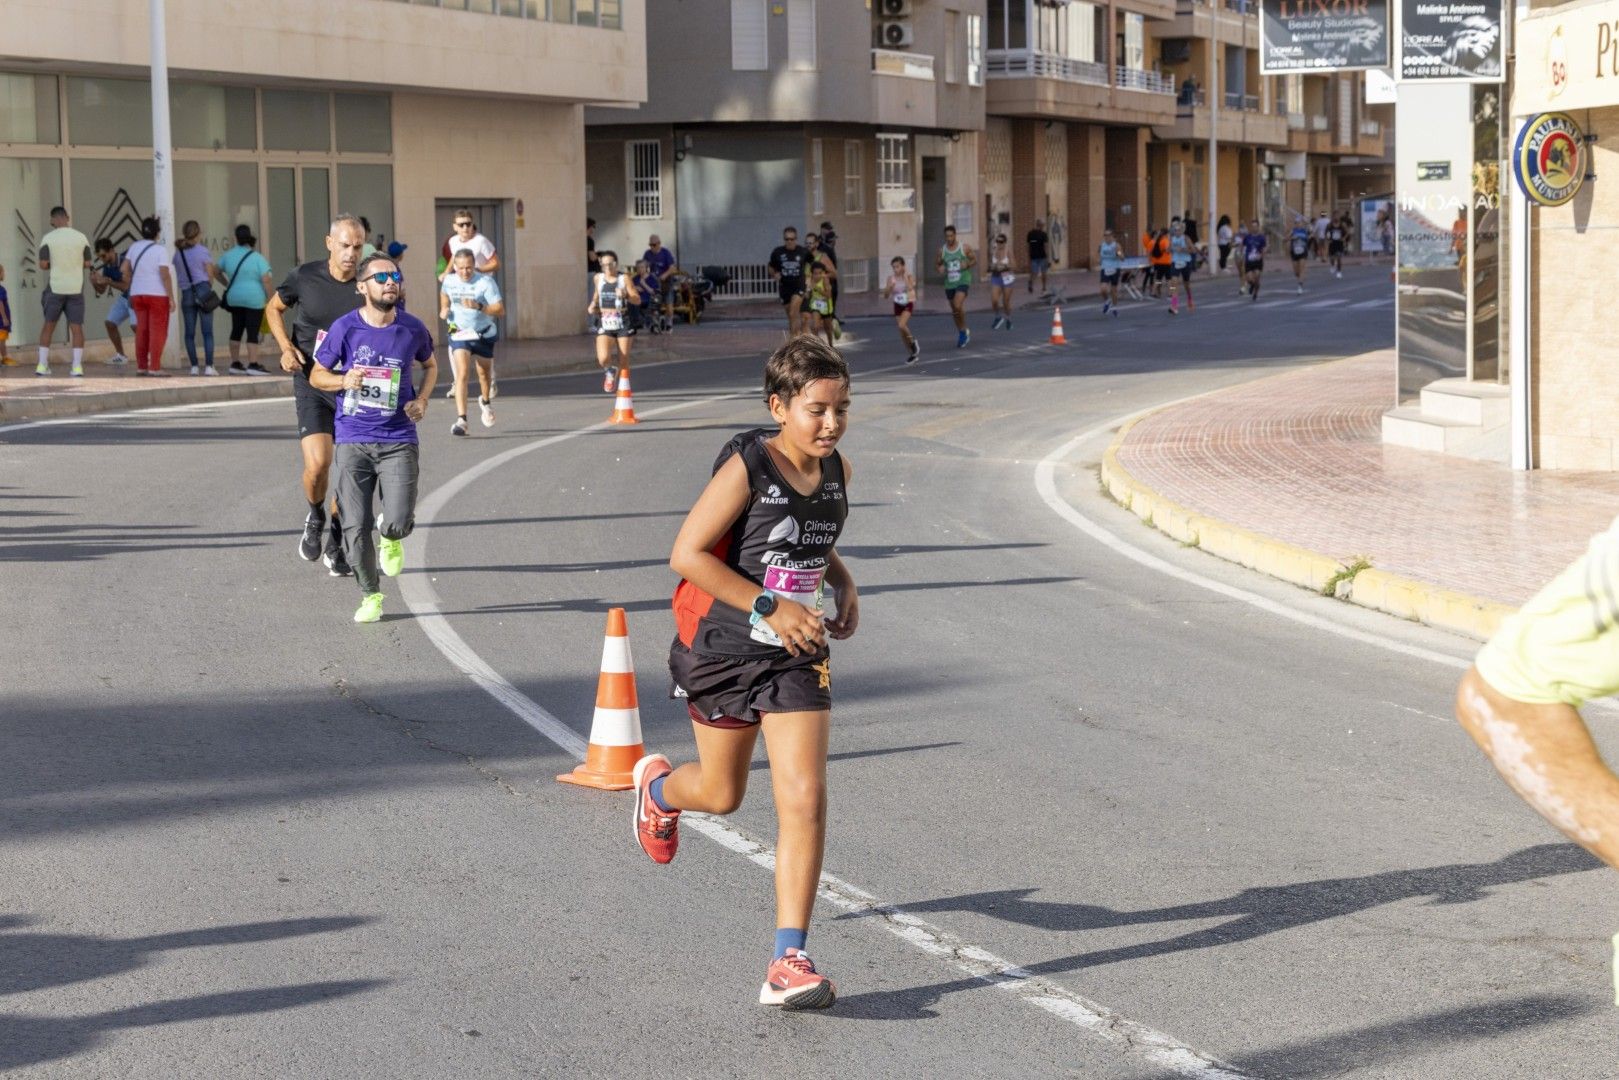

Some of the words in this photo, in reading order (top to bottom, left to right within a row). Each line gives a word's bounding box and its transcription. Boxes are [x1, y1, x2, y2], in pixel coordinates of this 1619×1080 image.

[1288, 18, 1322, 30] Beauty
[360, 385, 381, 399] 53
[761, 497, 789, 505] VIATOR
[804, 520, 837, 532] Clínica
[801, 533, 834, 545] Gioia
